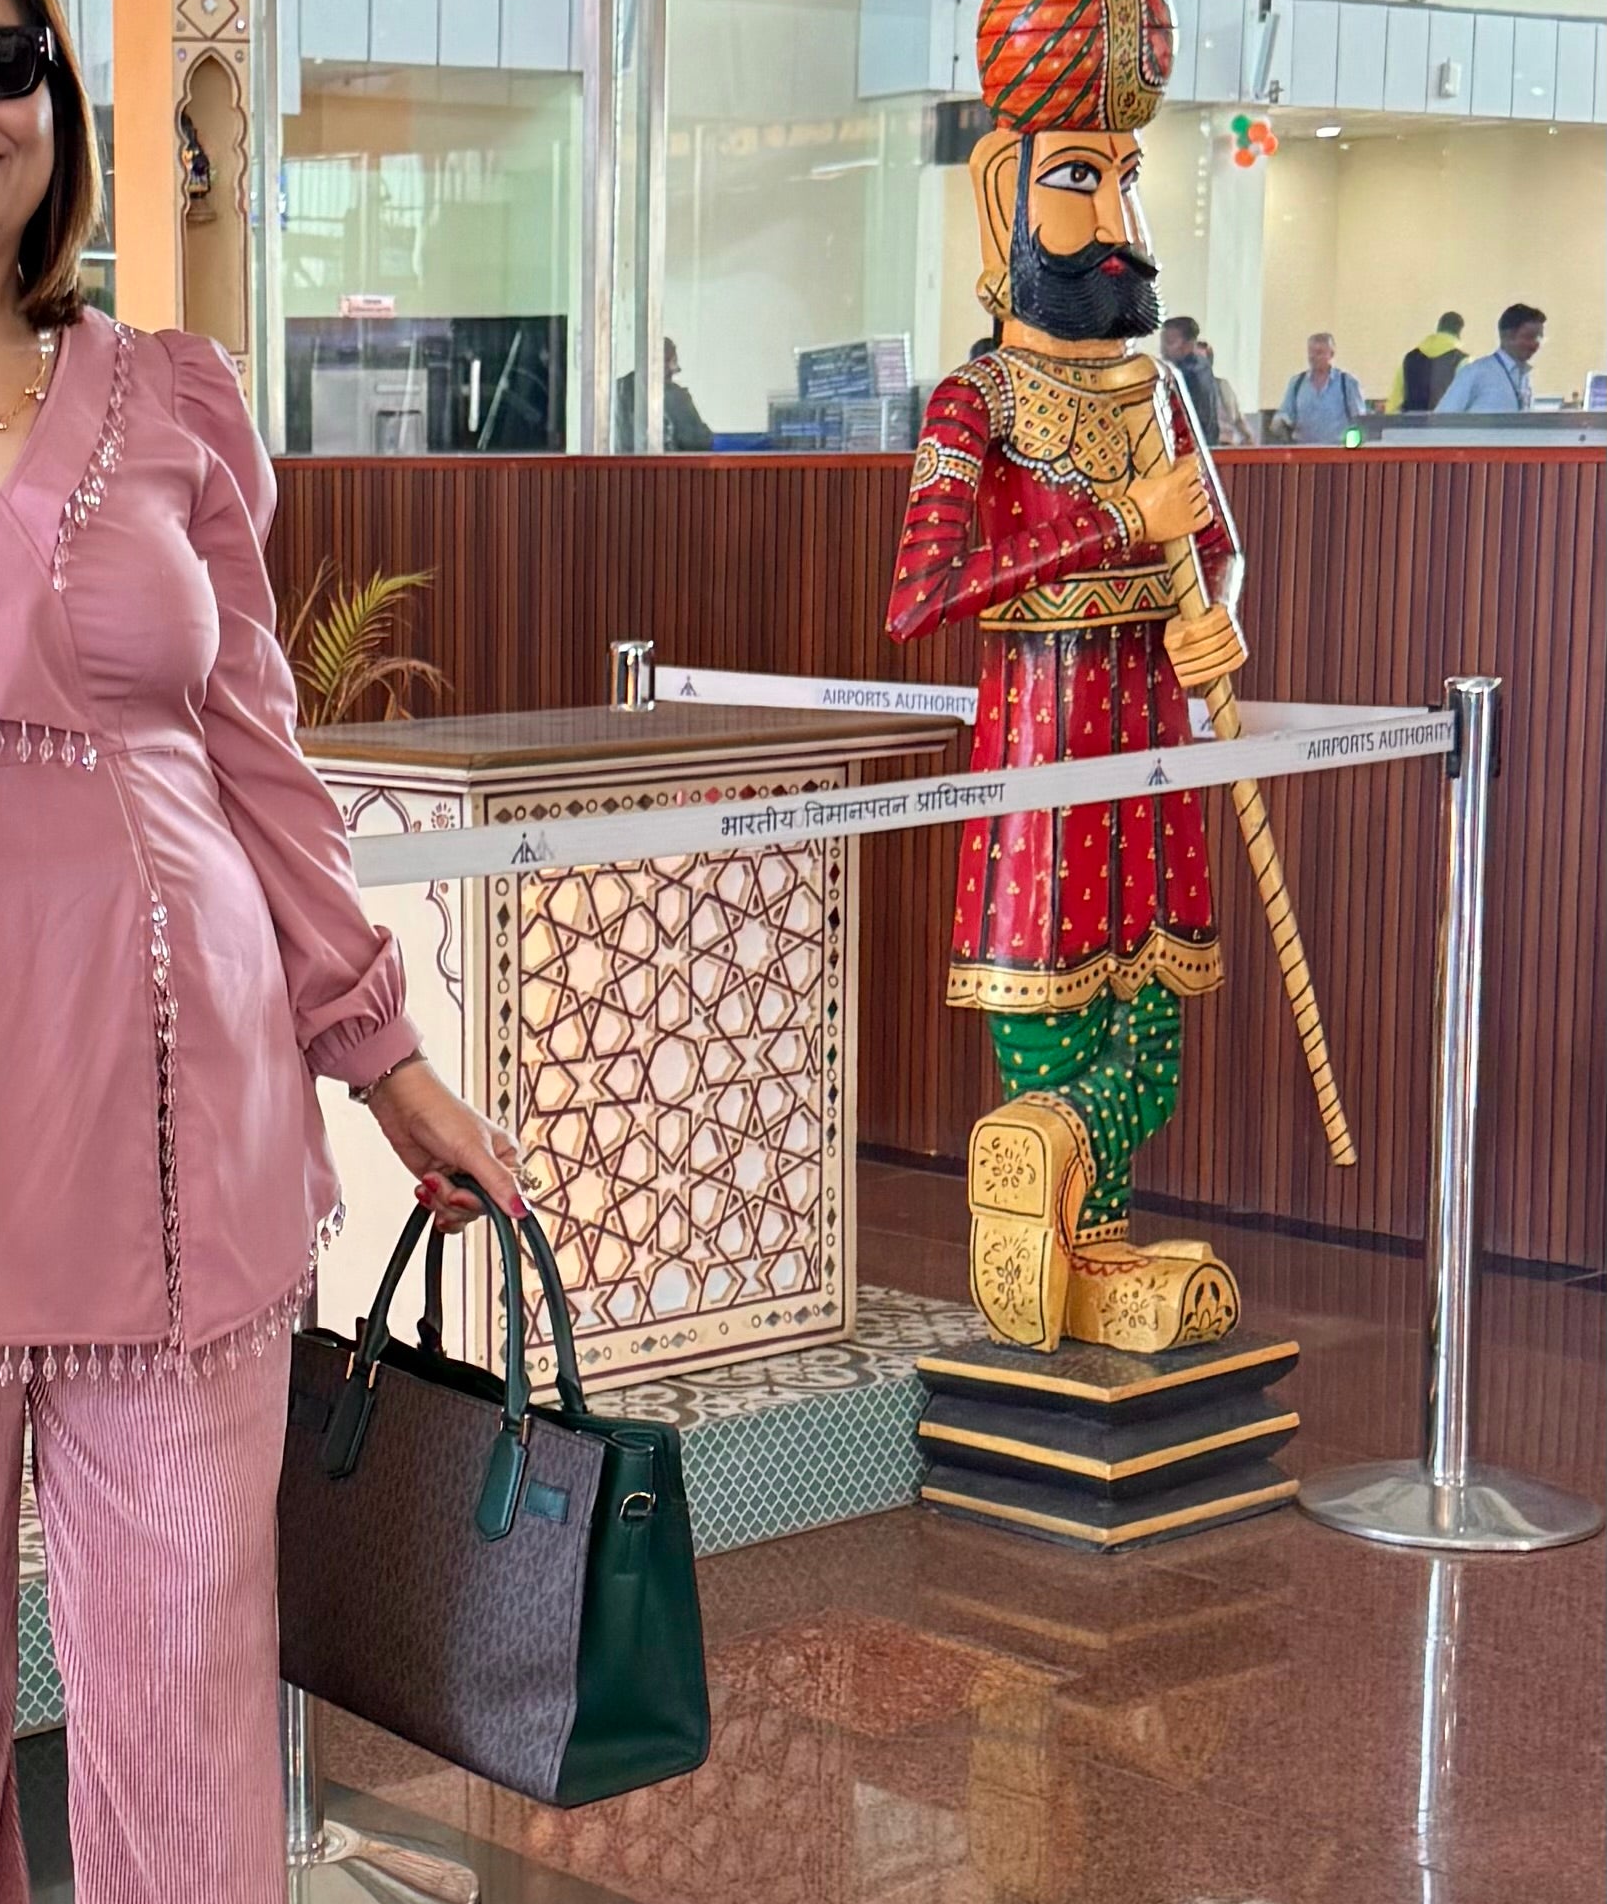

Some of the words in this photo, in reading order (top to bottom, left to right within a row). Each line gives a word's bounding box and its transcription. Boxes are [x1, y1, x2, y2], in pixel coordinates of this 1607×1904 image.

[821, 687, 891, 709] AIRPORTS
[895, 692, 977, 714] AUTHORITY
[1307, 731, 1375, 761] AIRPORTS
[1378, 721, 1455, 750] AUTHORITY
[720, 805, 797, 837] भारतीय
[916, 781, 1007, 813] प्राधिकरण
